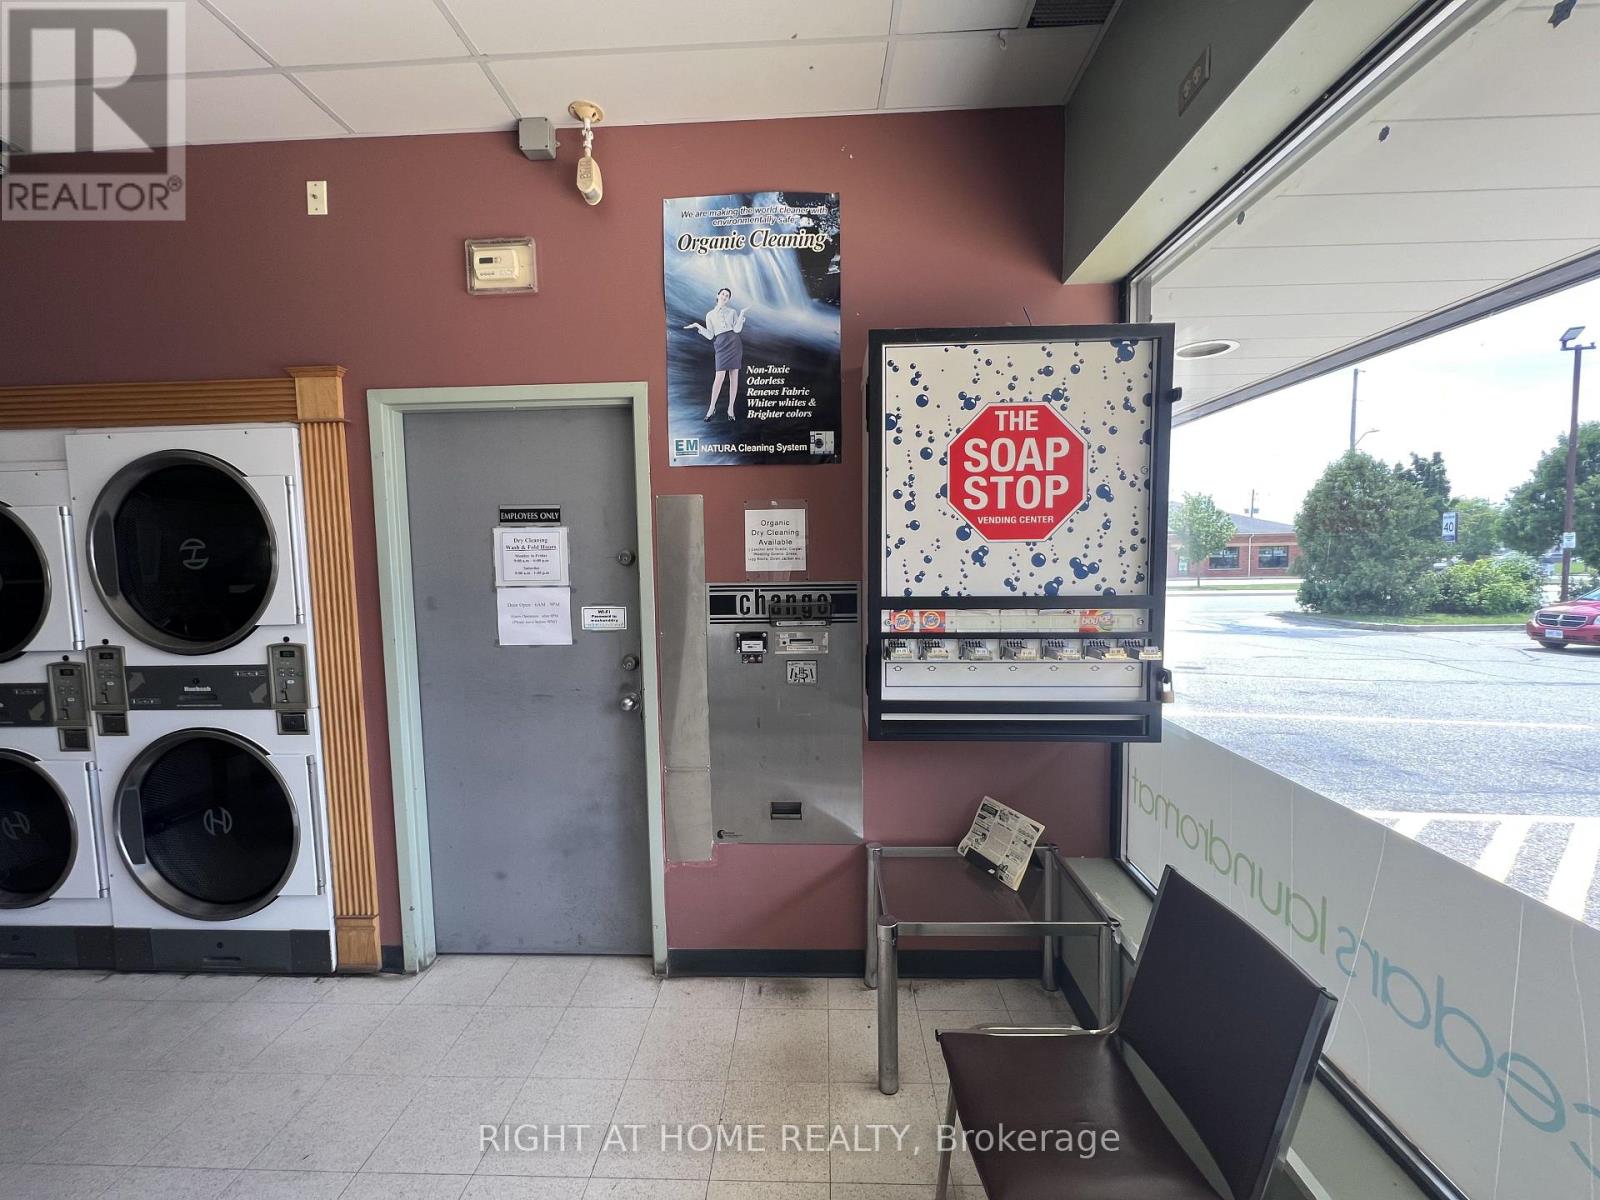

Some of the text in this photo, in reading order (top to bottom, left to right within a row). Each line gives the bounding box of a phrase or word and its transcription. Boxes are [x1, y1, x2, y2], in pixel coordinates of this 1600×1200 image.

[681, 204, 829, 218] We are making the world cleaner with
[712, 214, 776, 226] environmentally
[677, 229, 828, 255] Organic Cleaning
[746, 365, 790, 374] Non-Toxic
[746, 376, 786, 386] Odorless
[746, 386, 811, 397] Renews Fabric
[747, 397, 817, 408] Whiter whites &
[747, 408, 813, 421] Brighter colors
[994, 410, 1039, 431] THE
[675, 439, 808, 454] EM NATURA Cleaning System
[963, 436, 1070, 473] SOAP
[963, 475, 1069, 510] STOP
[500, 511, 560, 520] EMPLOYEES ONLY
[978, 515, 1054, 524] VENDING CENTER
[760, 519, 790, 527] Organic
[1443, 521, 1454, 532] 40
[751, 529, 764, 537] Dry
